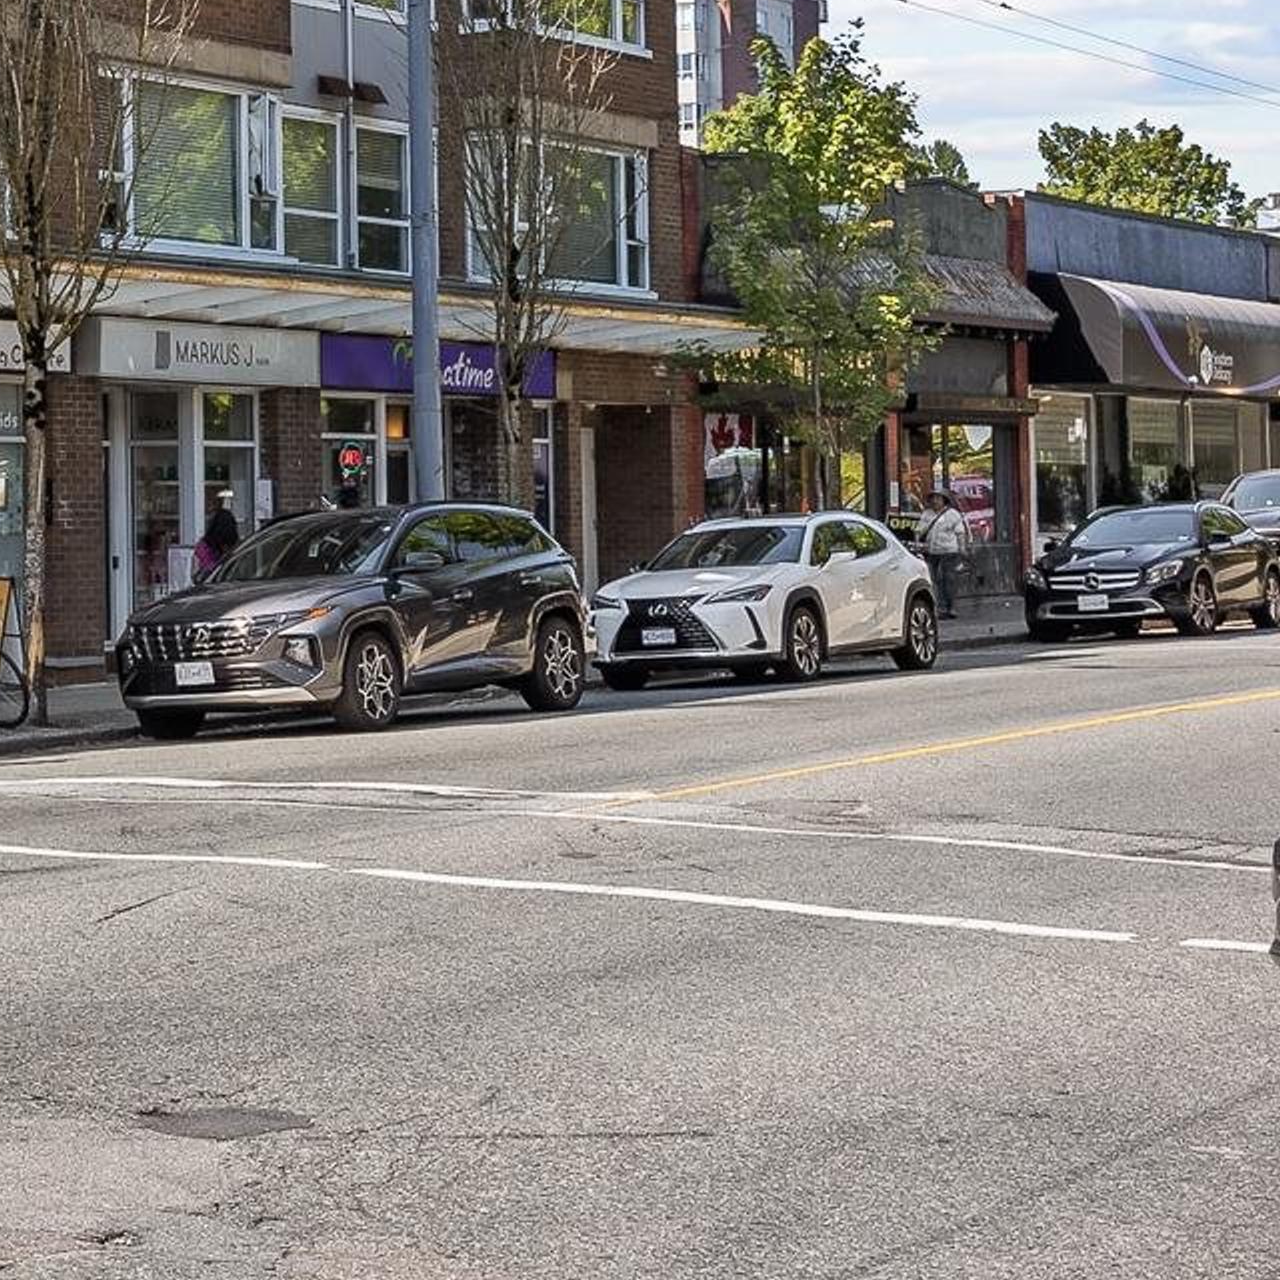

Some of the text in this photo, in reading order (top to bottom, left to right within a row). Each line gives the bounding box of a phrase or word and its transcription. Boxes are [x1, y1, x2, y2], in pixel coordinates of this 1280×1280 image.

[175, 340, 255, 368] MARKUS J
[443, 351, 495, 389] atime
